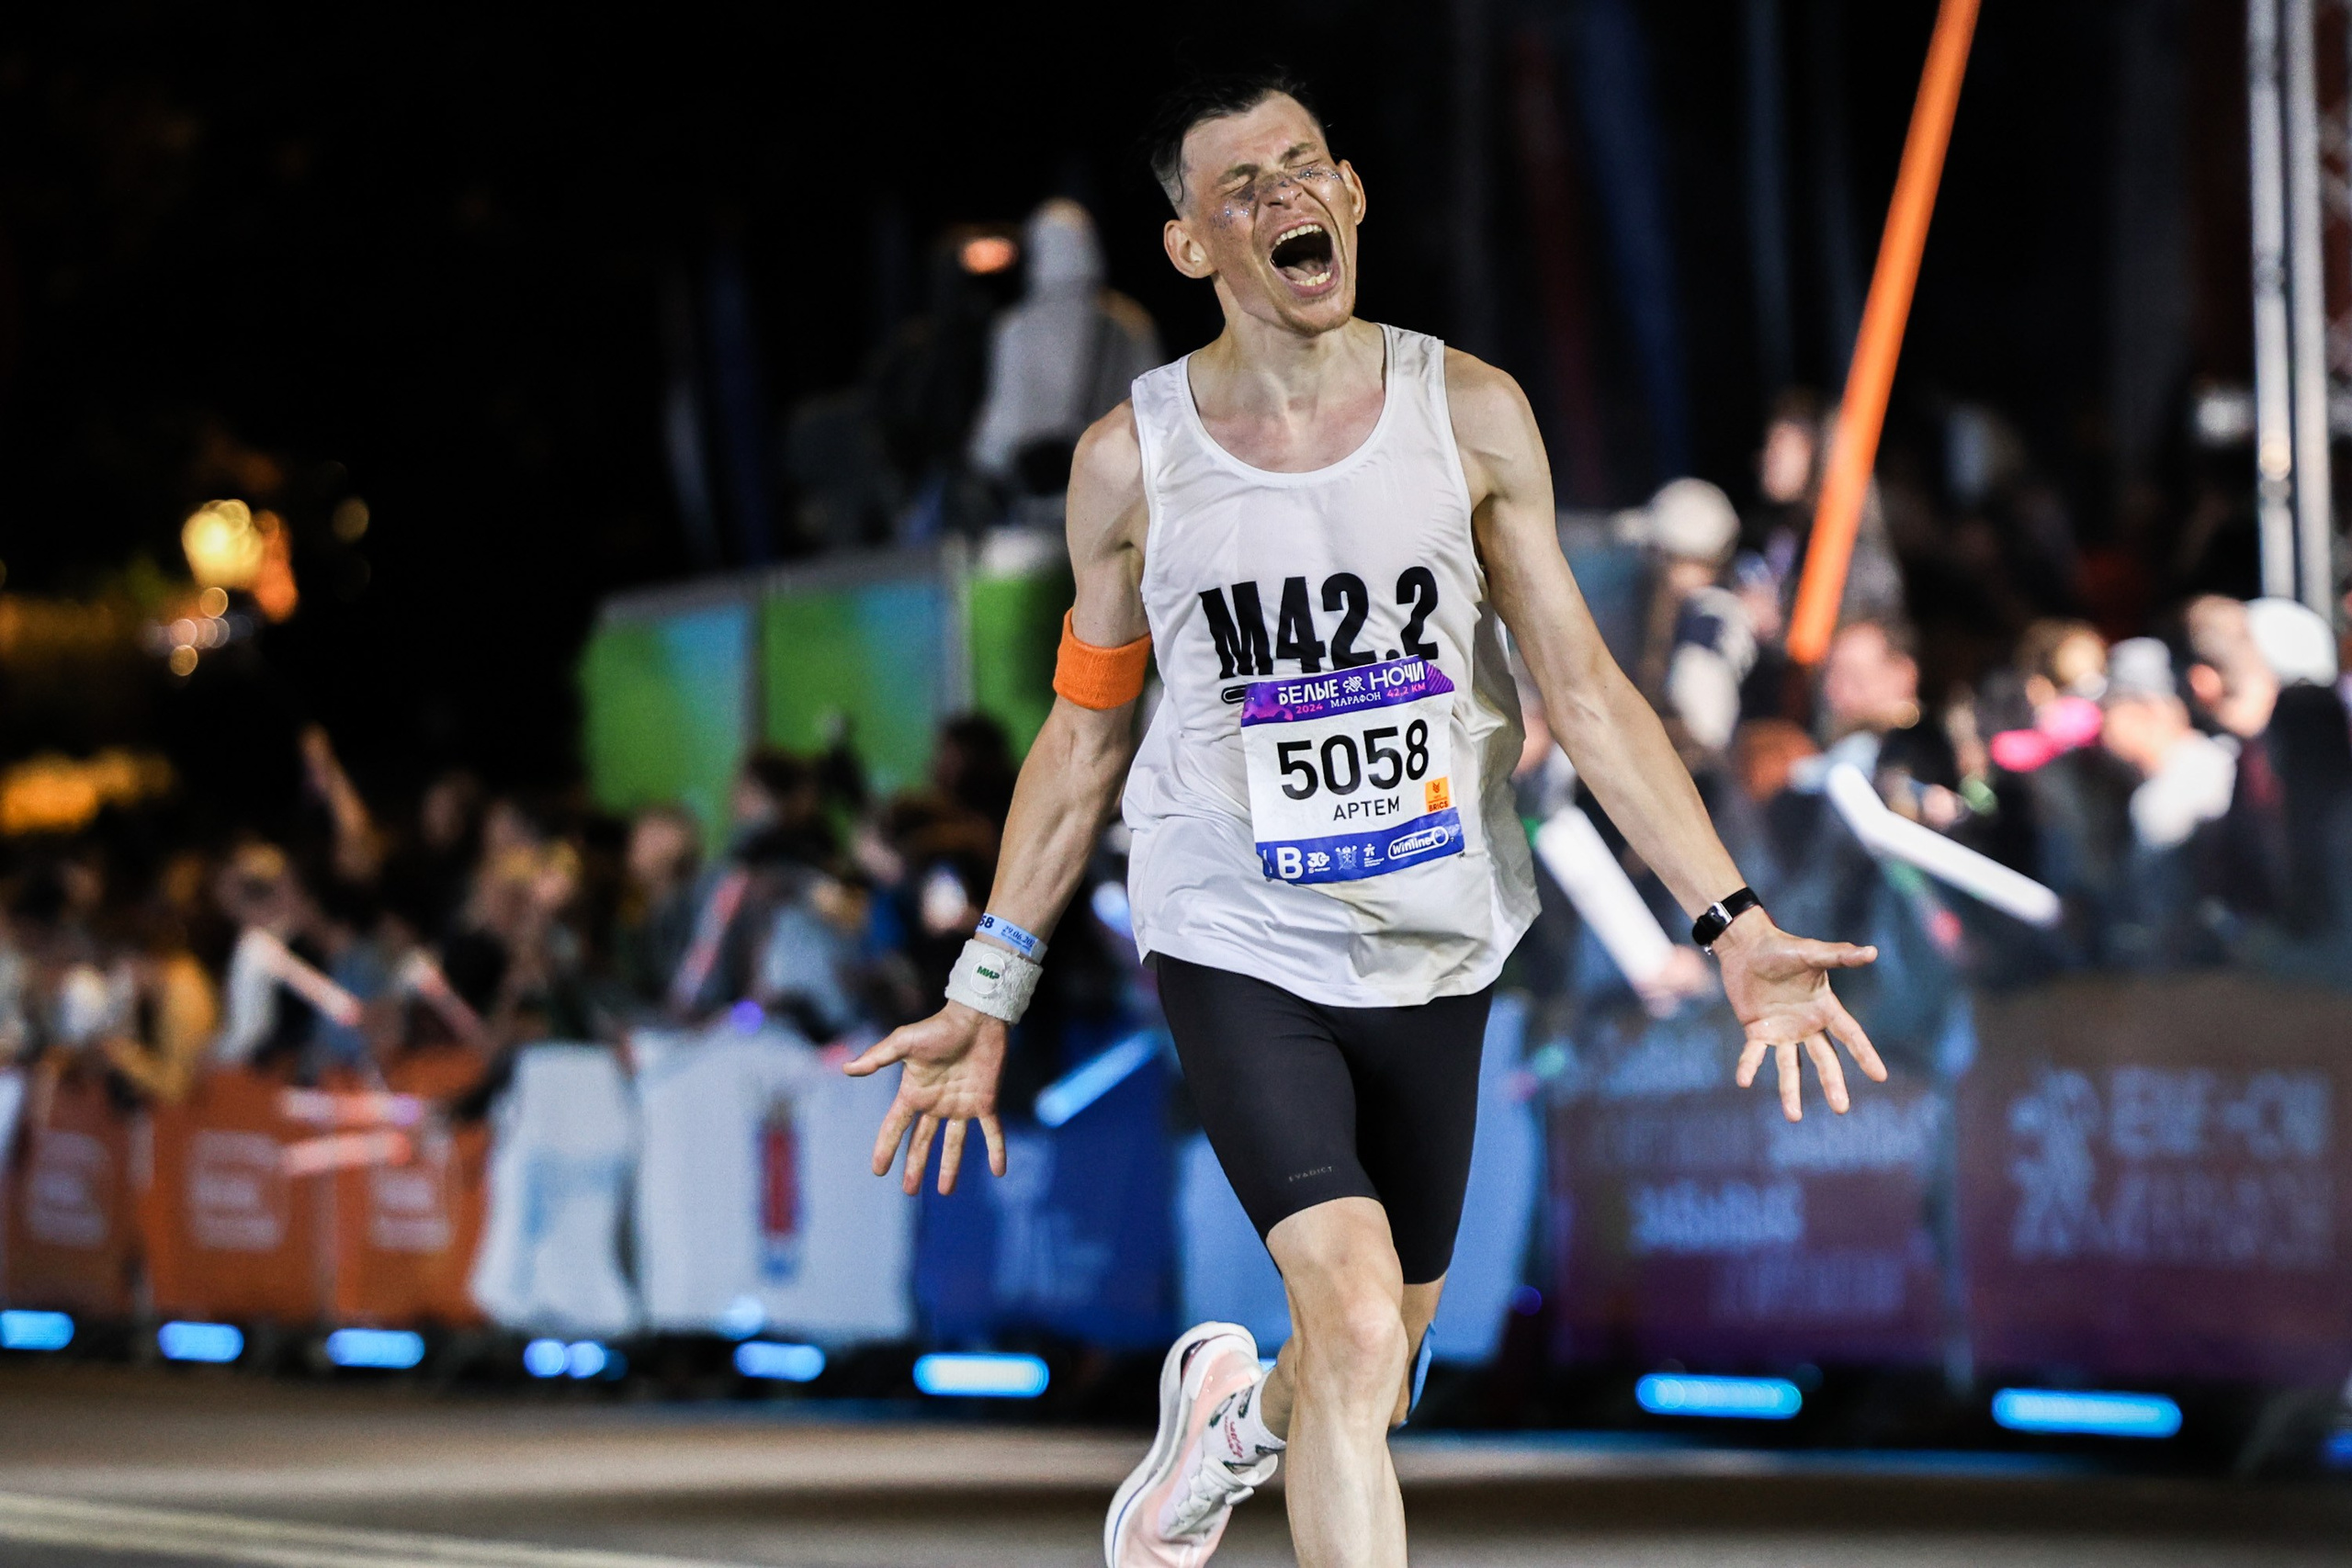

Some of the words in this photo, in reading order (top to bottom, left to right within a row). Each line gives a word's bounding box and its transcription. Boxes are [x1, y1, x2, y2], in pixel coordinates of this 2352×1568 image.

[1278, 678, 1340, 705] БЕЛЫЕ
[1370, 661, 1426, 690] НОЧИ
[1295, 704, 1324, 714] 2024
[1330, 692, 1381, 708] МАРАФОН
[1276, 718, 1430, 800] 5058
[1332, 795, 1401, 821] АРТЕМ
[1429, 801, 1449, 812] BRICS
